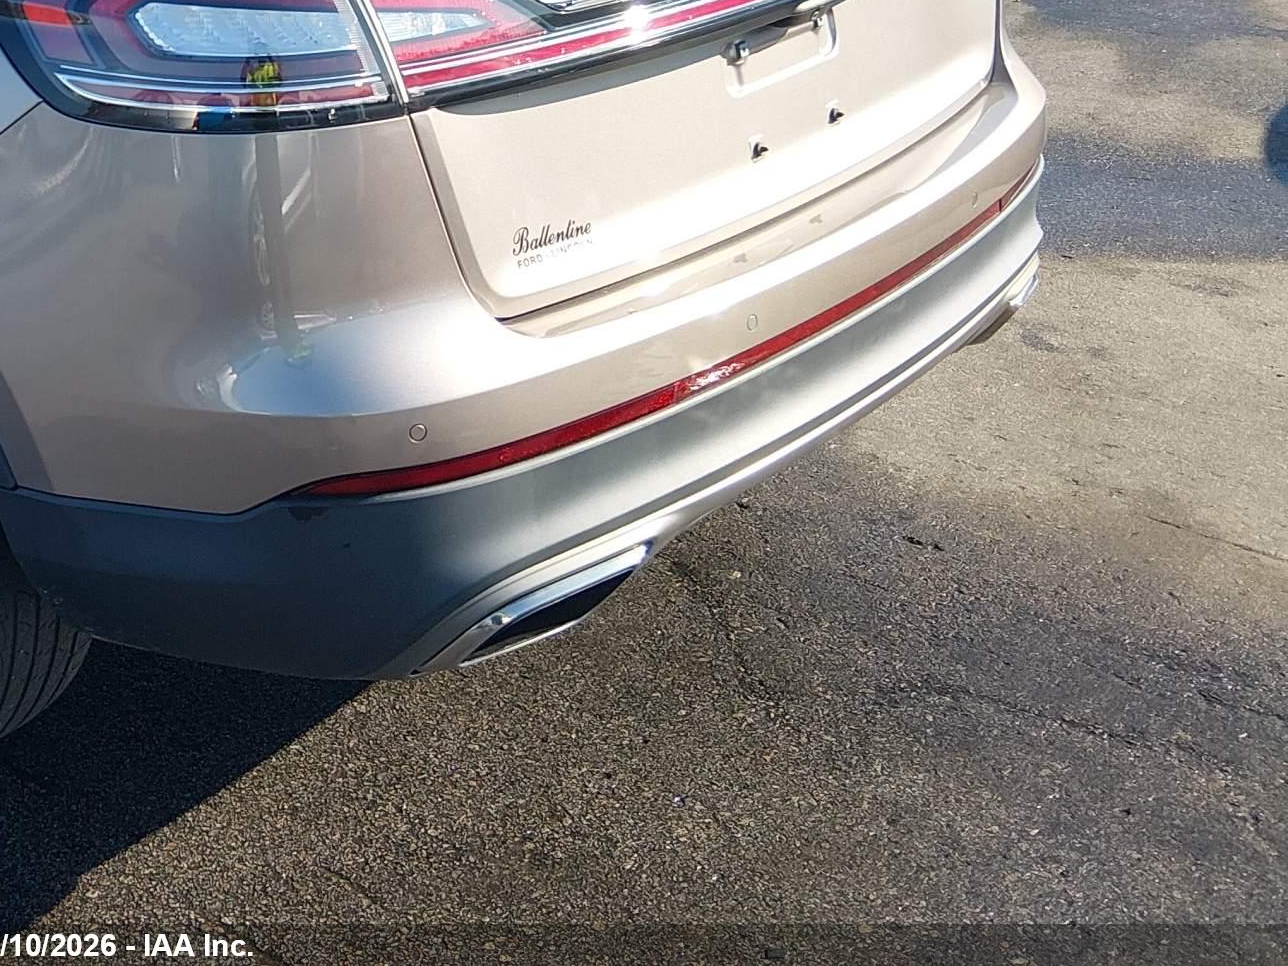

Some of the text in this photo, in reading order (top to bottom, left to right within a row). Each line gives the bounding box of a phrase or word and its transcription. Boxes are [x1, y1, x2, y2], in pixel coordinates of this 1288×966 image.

[512, 219, 592, 257] Ballentine
[516, 238, 593, 270] FORD LINCON
